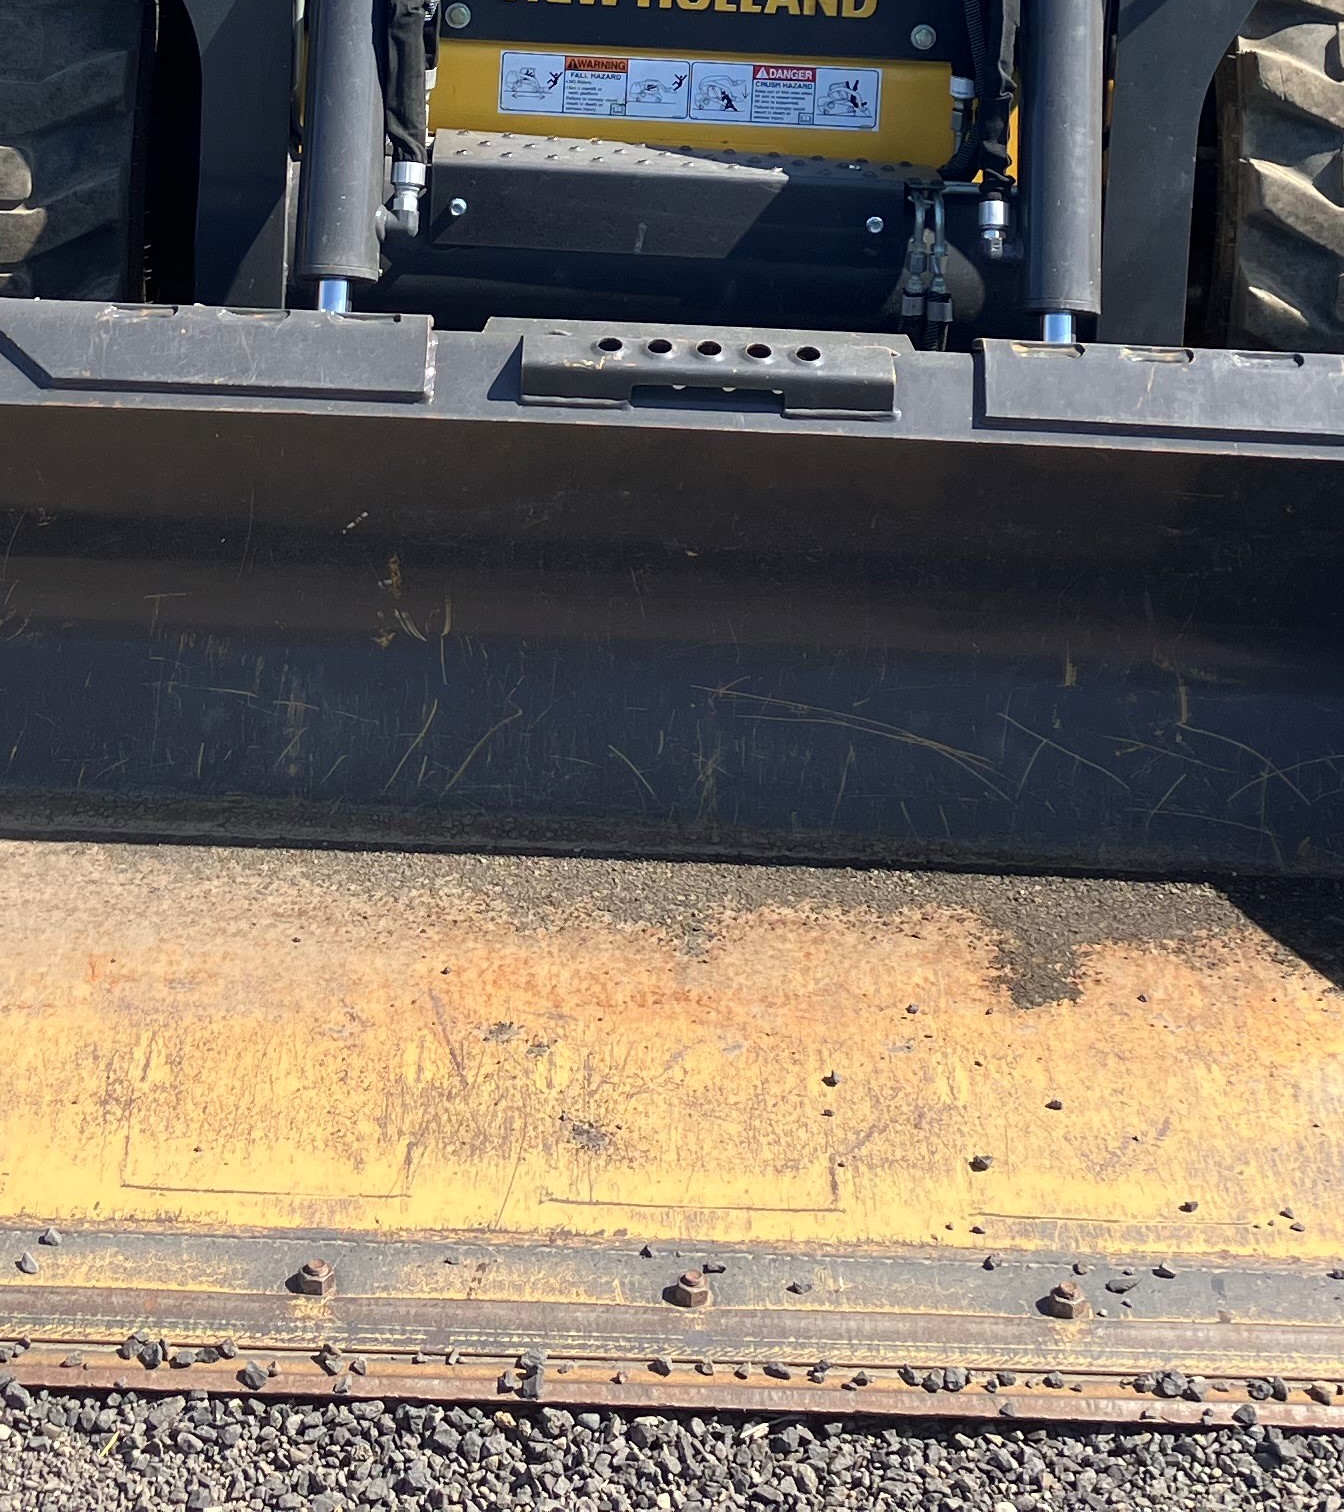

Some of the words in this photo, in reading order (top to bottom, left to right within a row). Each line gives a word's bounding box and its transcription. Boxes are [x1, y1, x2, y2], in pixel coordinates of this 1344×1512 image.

[577, 59, 626, 71] WARNING
[570, 71, 589, 79] FALL
[590, 73, 622, 81] HAZARD
[769, 68, 813, 80] DANGER
[755, 80, 781, 88] CRUSH
[782, 82, 813, 90] HAZARD
